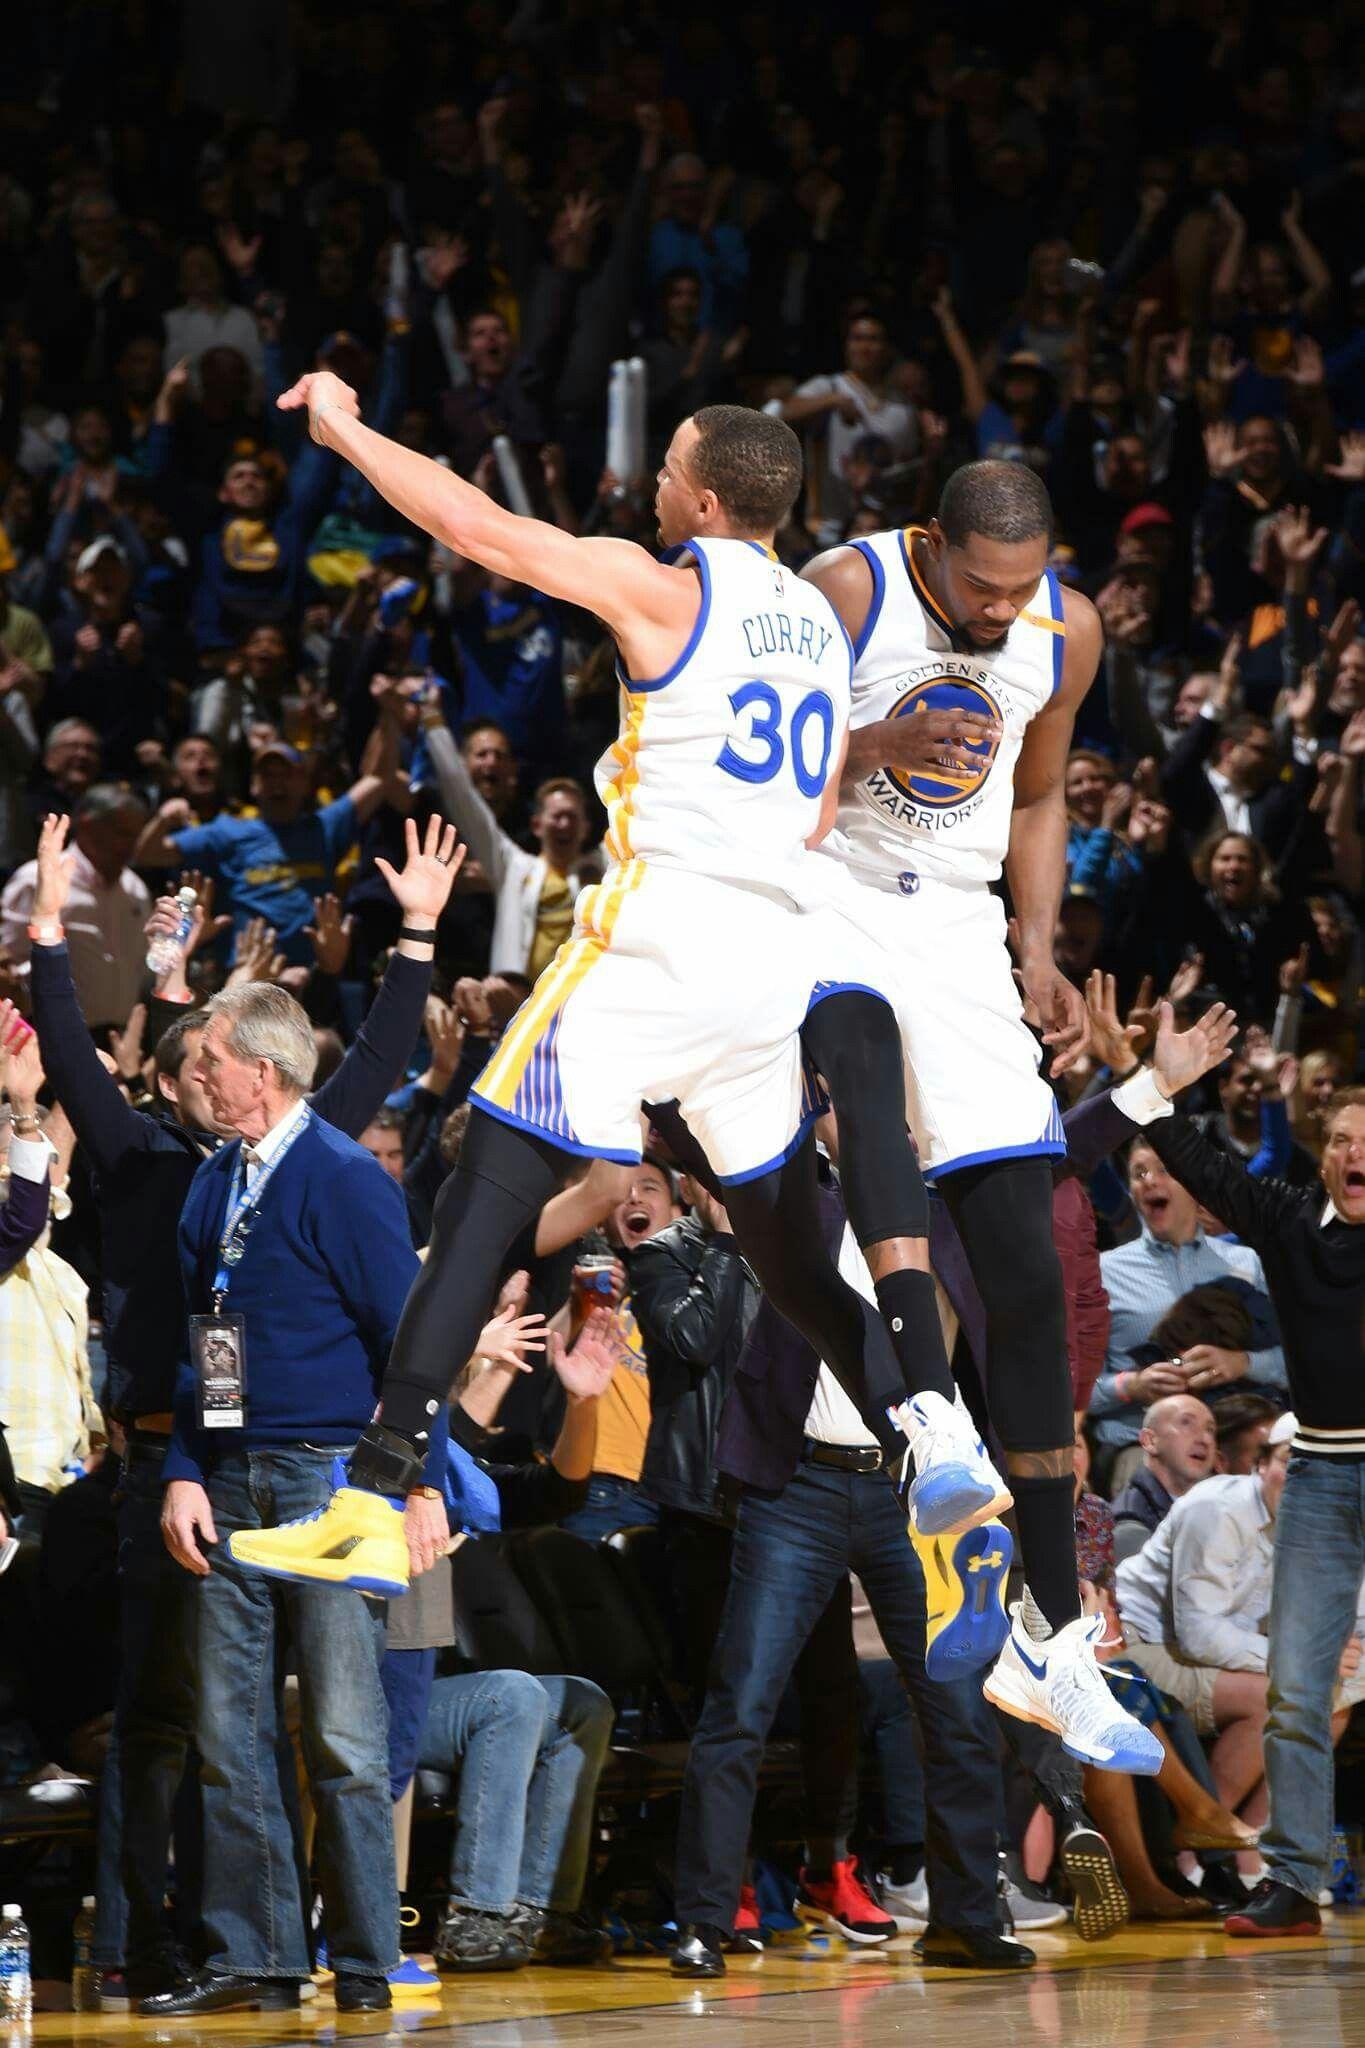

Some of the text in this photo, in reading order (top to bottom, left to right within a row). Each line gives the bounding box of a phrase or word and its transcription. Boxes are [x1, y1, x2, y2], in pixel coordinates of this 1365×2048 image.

[742, 613, 832, 665] CURRY
[895, 661, 1015, 720] GOLDEN STATE
[713, 679, 833, 799] 30
[866, 769, 984, 830] WARRIORS
